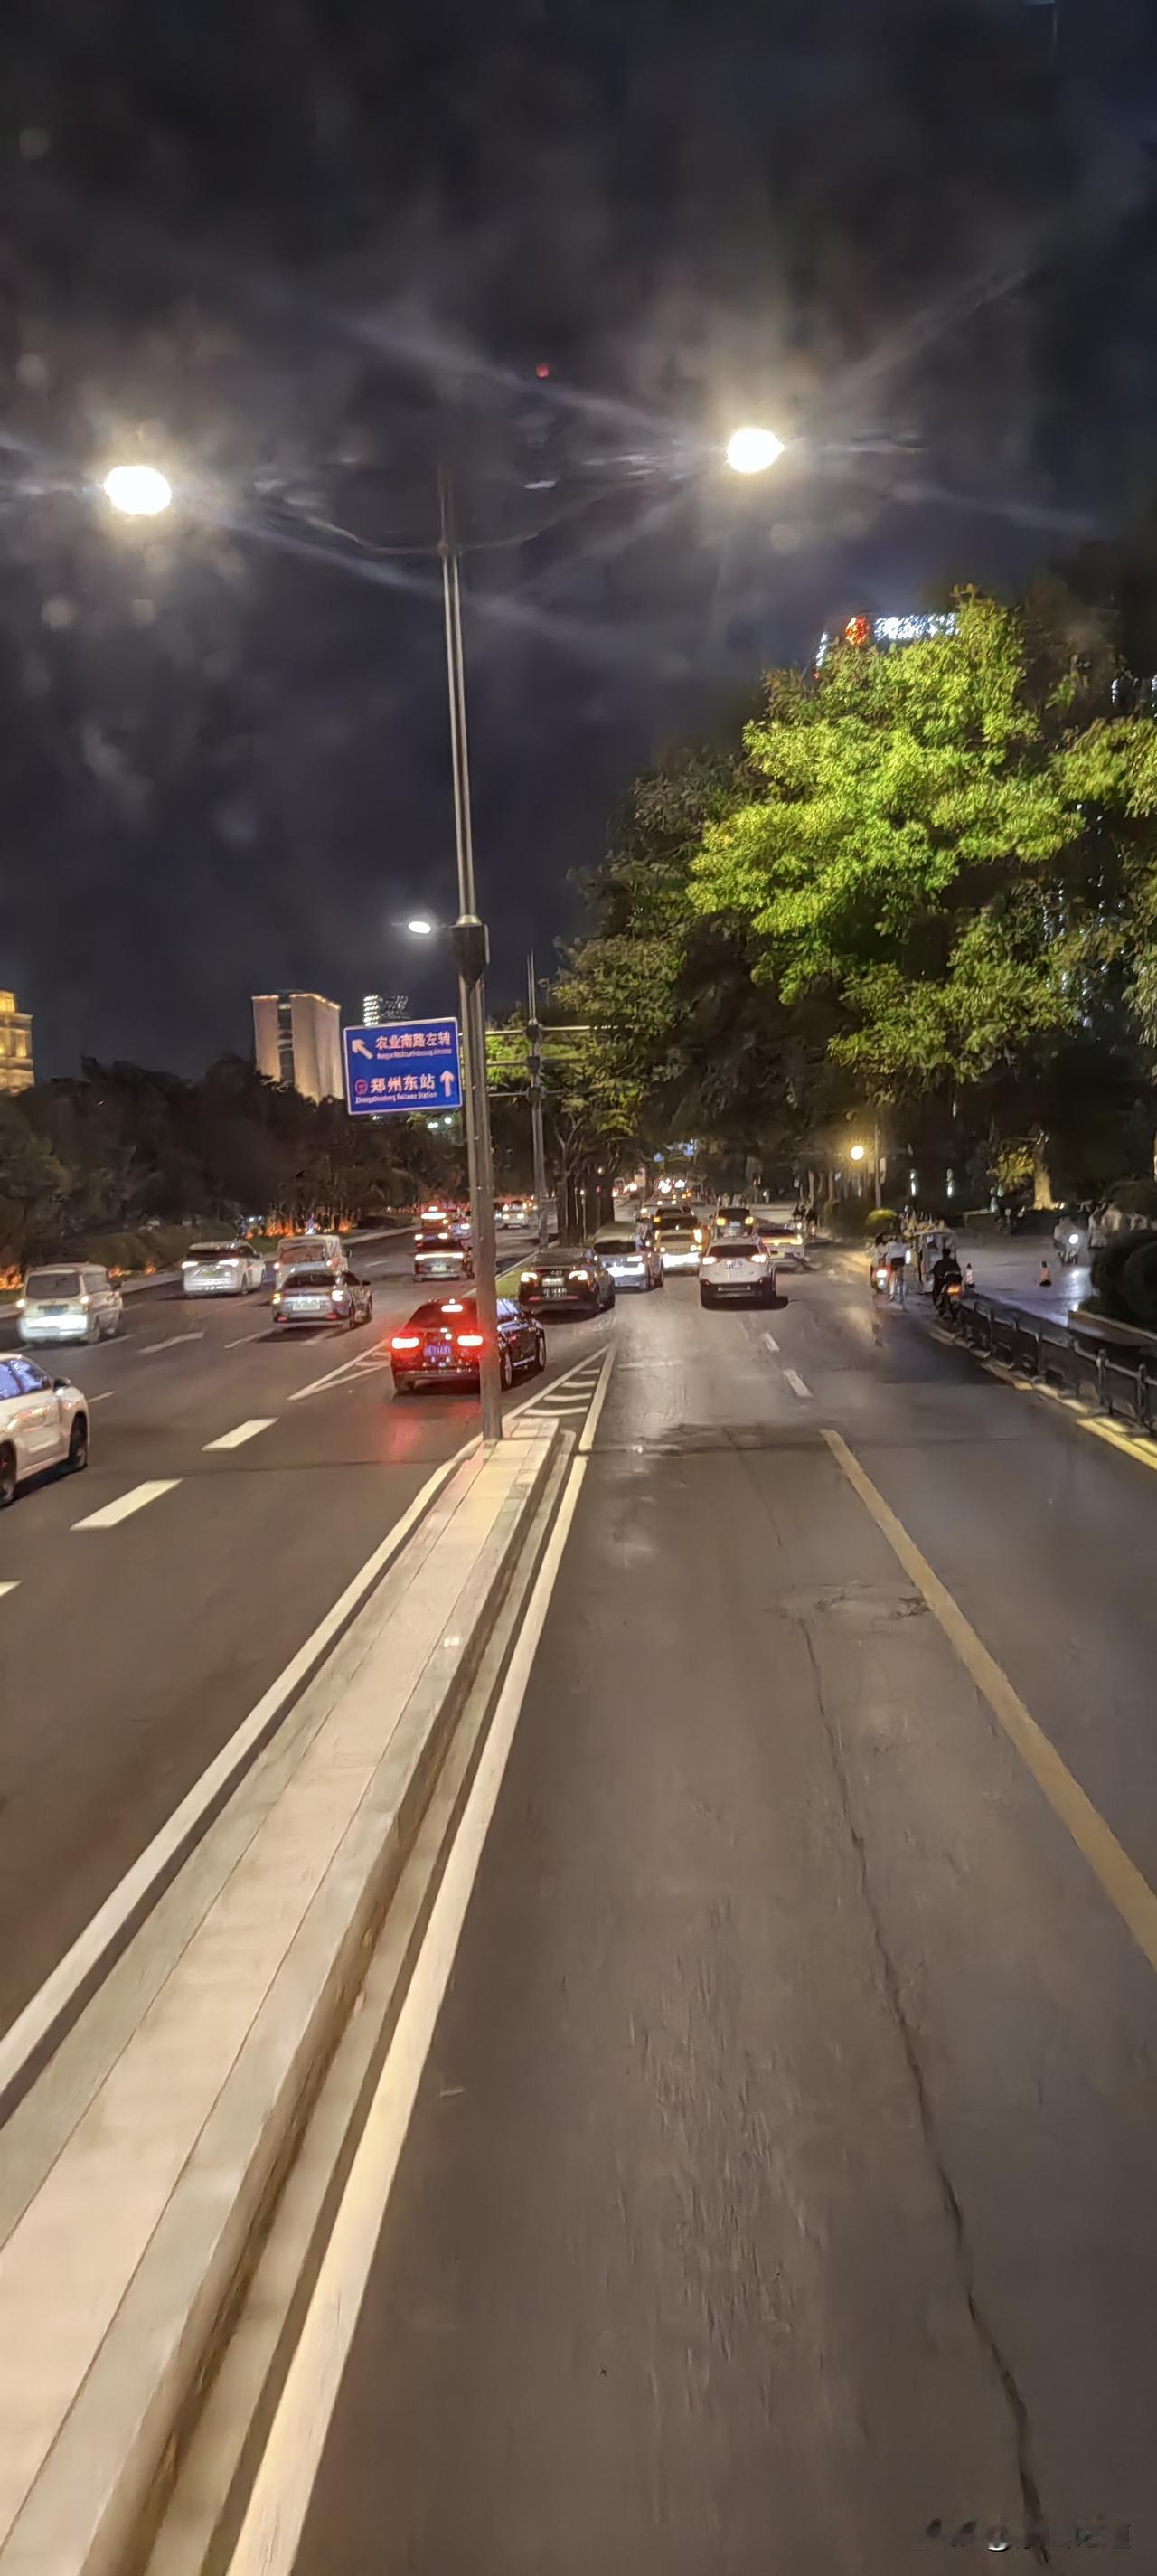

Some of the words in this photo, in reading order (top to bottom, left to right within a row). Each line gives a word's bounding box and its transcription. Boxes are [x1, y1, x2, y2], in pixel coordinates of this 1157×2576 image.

[375, 1031, 451, 1050] 农业南路左转
[371, 1073, 436, 1094] 郑州东站
